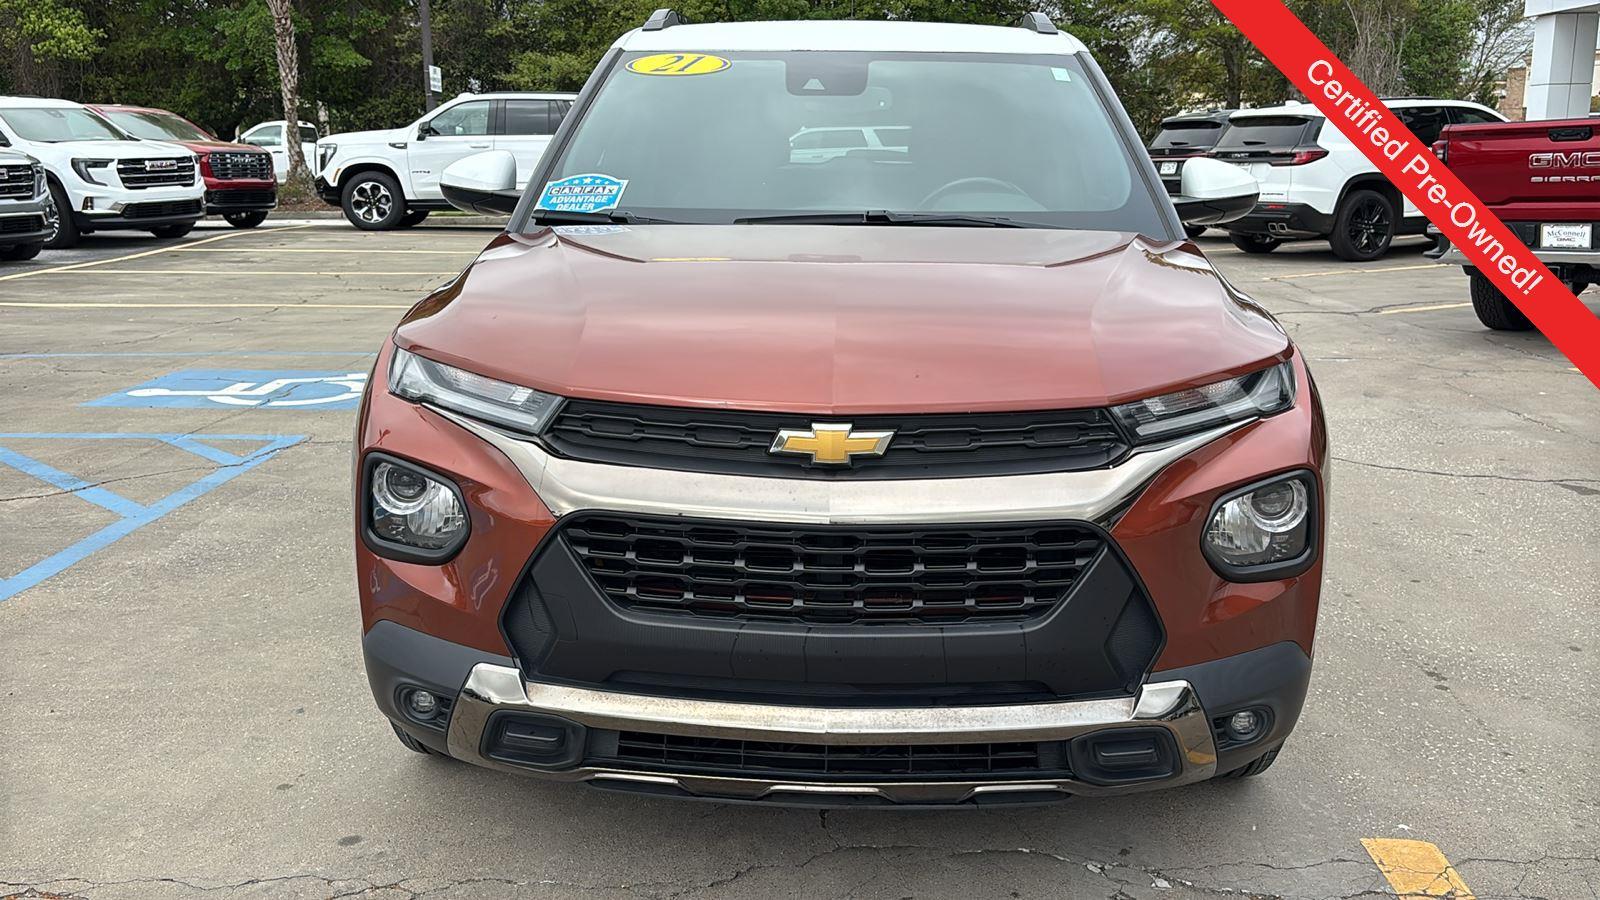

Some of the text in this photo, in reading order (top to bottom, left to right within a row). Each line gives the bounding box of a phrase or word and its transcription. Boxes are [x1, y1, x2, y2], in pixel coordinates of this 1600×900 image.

[649, 55, 706, 72] 21
[1528, 152, 1600, 168] GMC
[549, 185, 619, 196] CARFAX
[549, 195, 609, 204] ADVANTAGE
[556, 203, 595, 211] DEALER
[1547, 230, 1586, 238] McConnell
